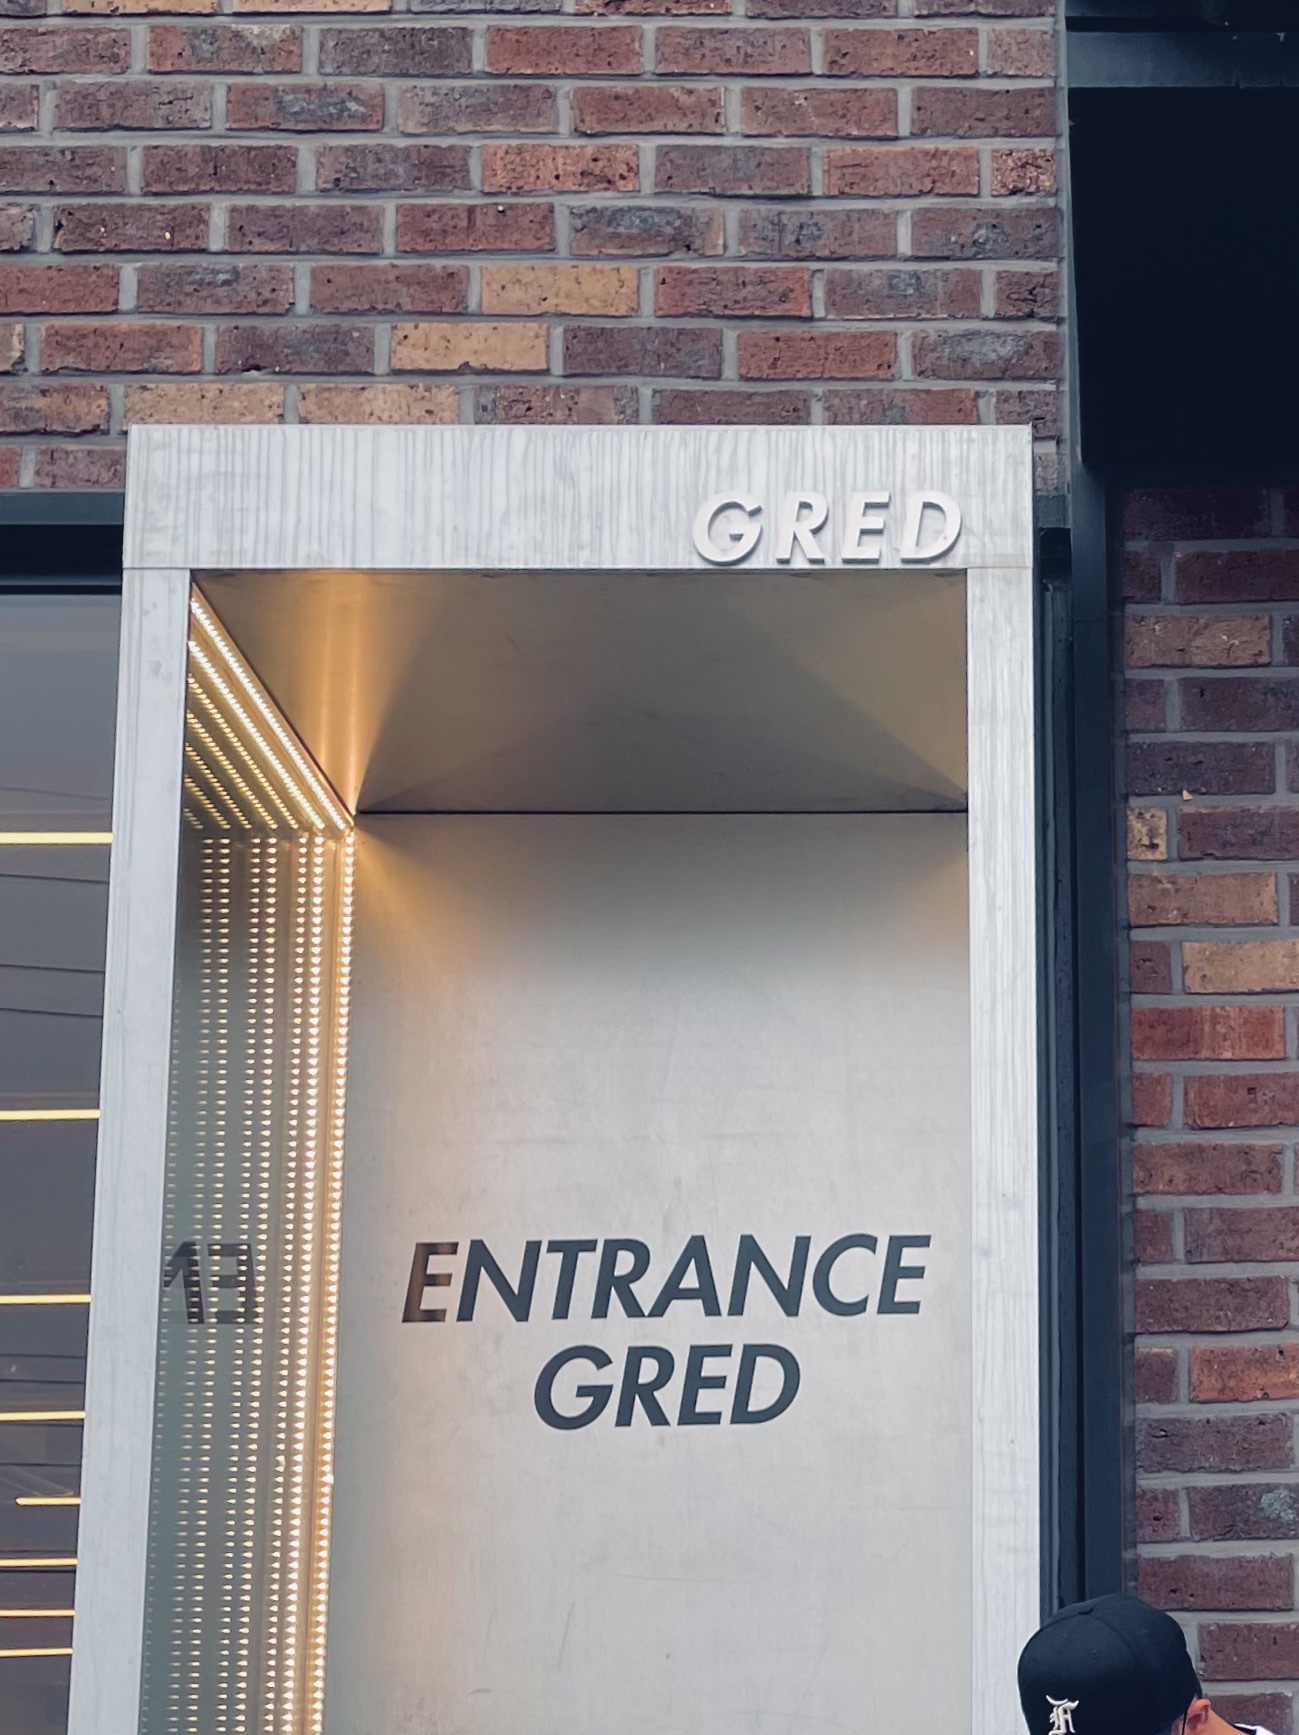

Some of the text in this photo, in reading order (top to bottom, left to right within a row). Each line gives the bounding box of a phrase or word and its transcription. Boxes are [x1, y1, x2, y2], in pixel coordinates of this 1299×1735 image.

[693, 490, 962, 566] GRED
[403, 1233, 931, 1324] ENTRANCE
[533, 1344, 801, 1431] GRED
